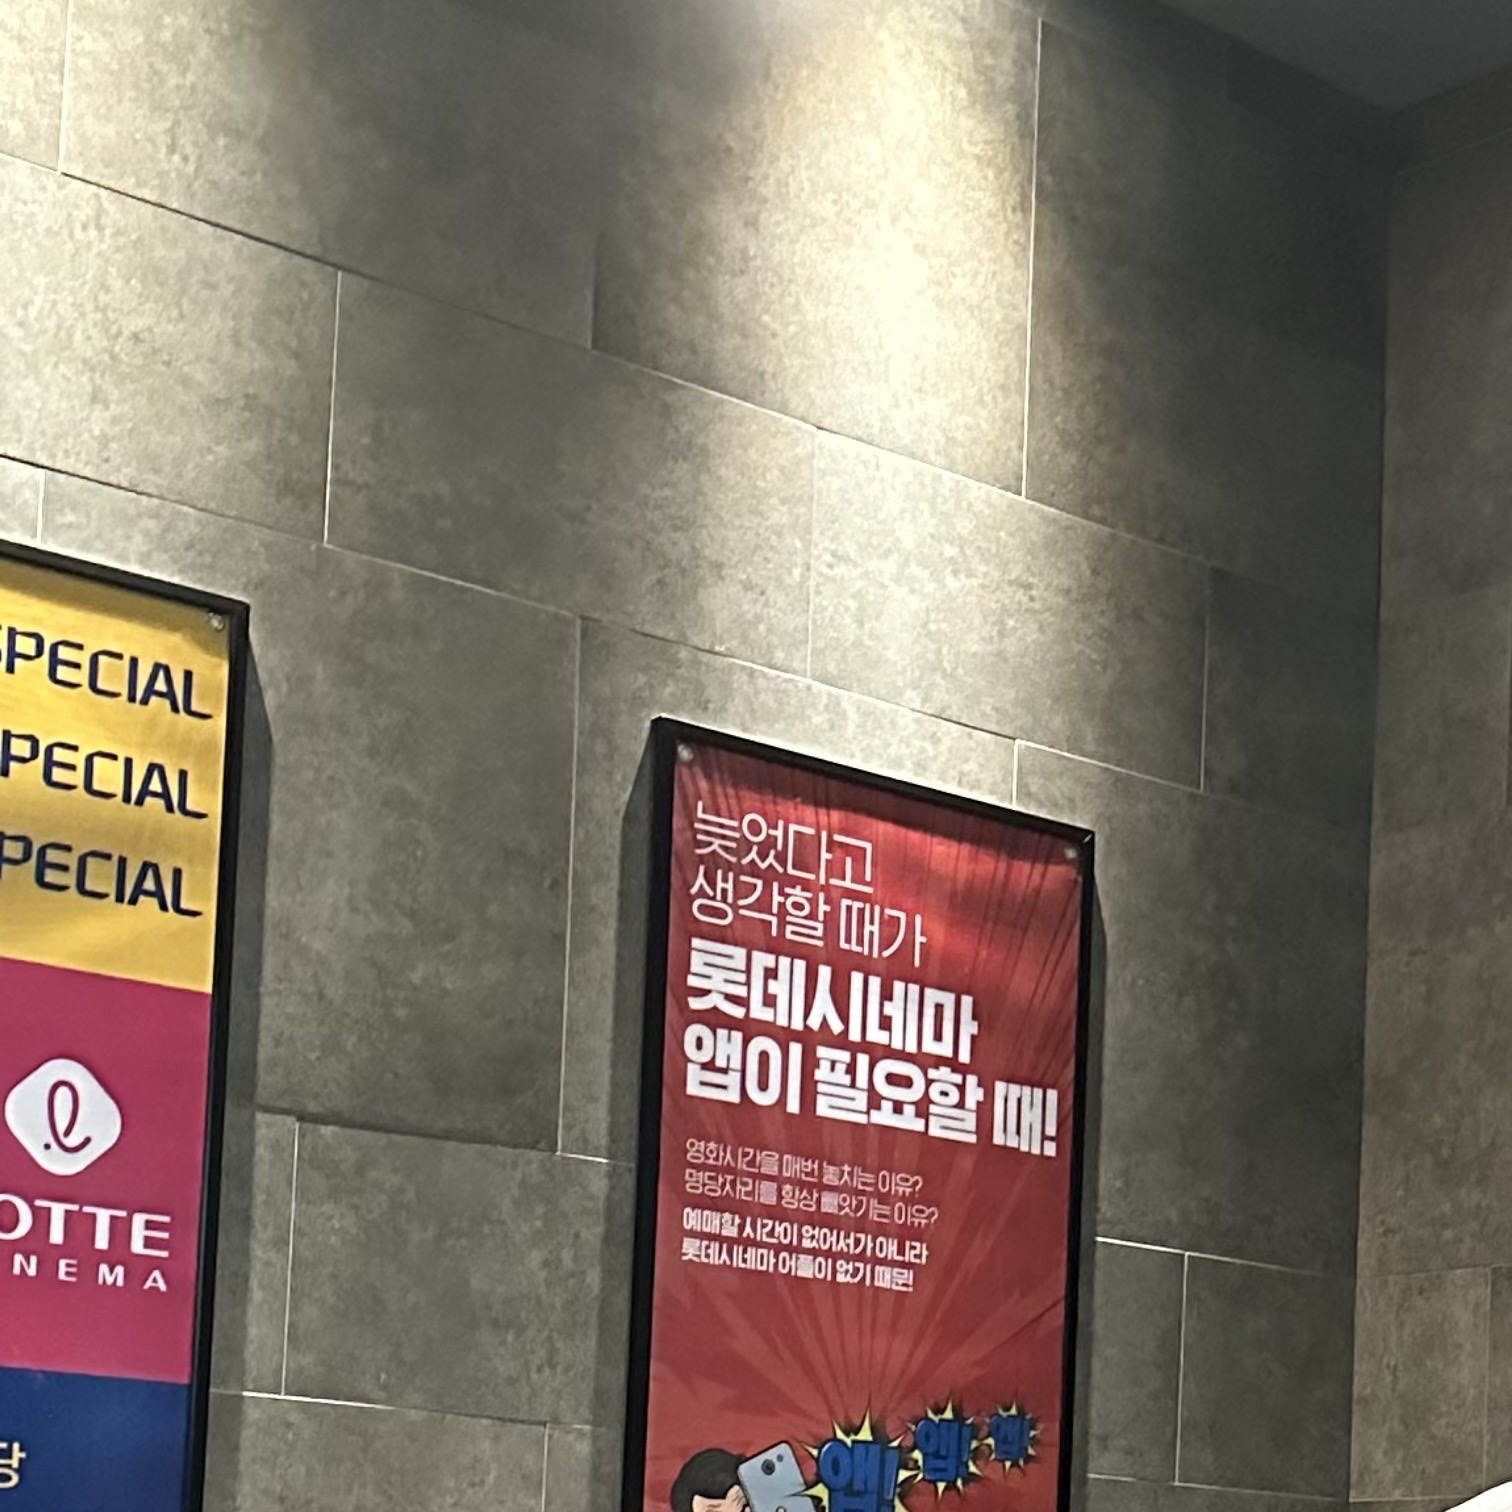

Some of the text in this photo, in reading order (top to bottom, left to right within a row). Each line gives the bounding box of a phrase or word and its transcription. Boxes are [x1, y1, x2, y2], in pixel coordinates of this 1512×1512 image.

[0, 624, 213, 720] PECIAL
[693, 801, 874, 894] 늦었다고
[689, 865, 928, 967] 생각할 때가
[687, 938, 979, 1063] 롯데시네마
[684, 1024, 1058, 1158] 앱이 필요할 때!
[685, 1168, 778, 1205] 명당자리를
[781, 1183, 819, 1212] 항상
[893, 1201, 939, 1228] 이유?
[686, 1138, 924, 1198] 영화시간을 매번 놓치는 이유?
[681, 1237, 776, 1273] 롯데시네마
[836, 1259, 871, 1287] 없기
[683, 1207, 929, 1265] 예매할 시간이 없어서가 아니라
